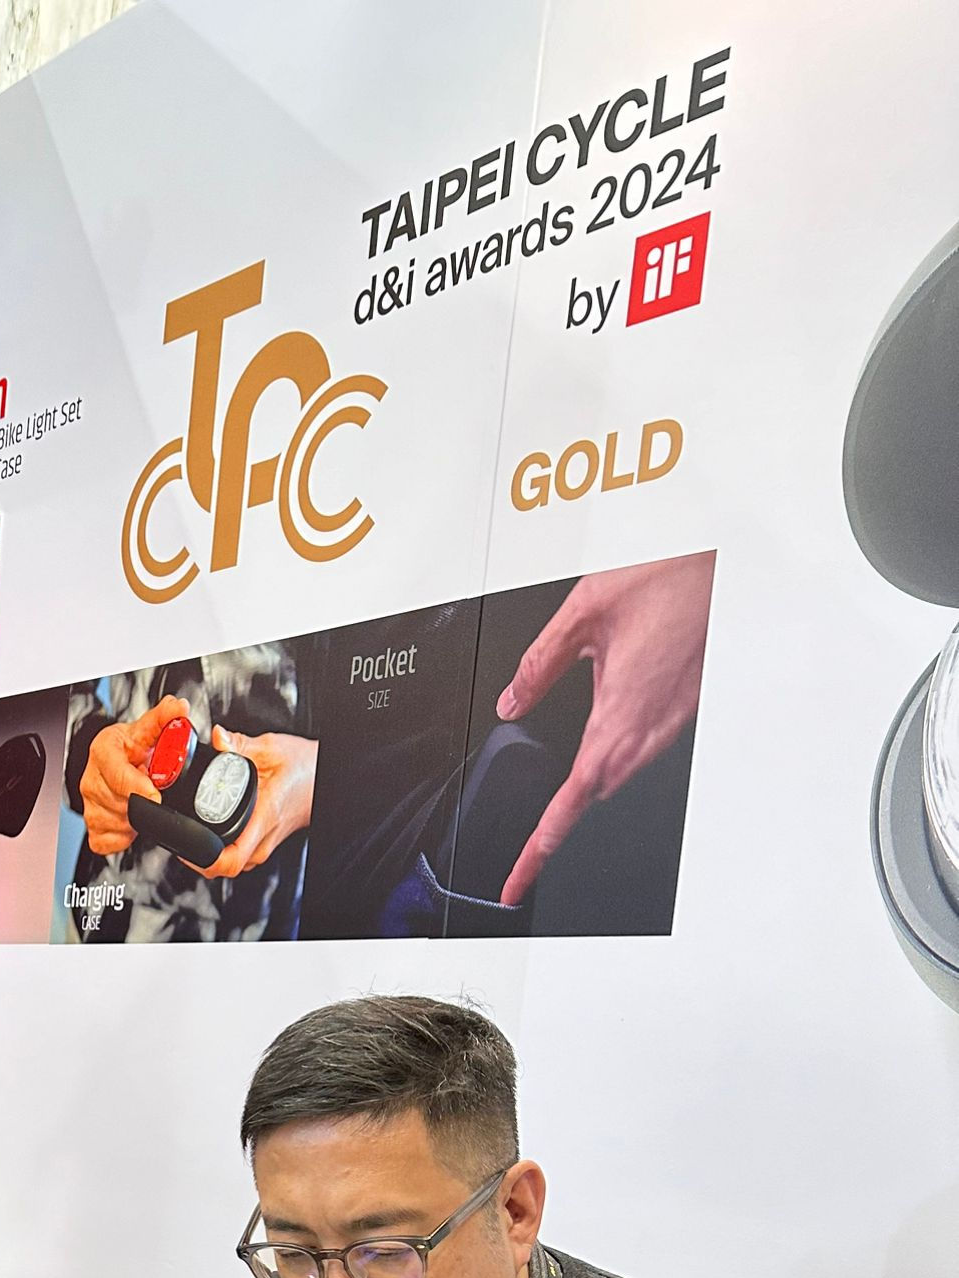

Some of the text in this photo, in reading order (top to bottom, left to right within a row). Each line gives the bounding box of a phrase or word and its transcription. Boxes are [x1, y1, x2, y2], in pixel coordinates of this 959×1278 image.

[361, 46, 732, 260] TAIPEI CYCLE
[353, 134, 722, 325] d&i awards 2024
[566, 278, 621, 334] by
[26, 405, 58, 441] Light
[61, 397, 83, 427] Set
[510, 418, 684, 512] GOLD
[349, 644, 417, 685] Pocket
[367, 689, 391, 711] SIZE
[63, 881, 125, 911] Charging
[82, 915, 101, 930] CASE
